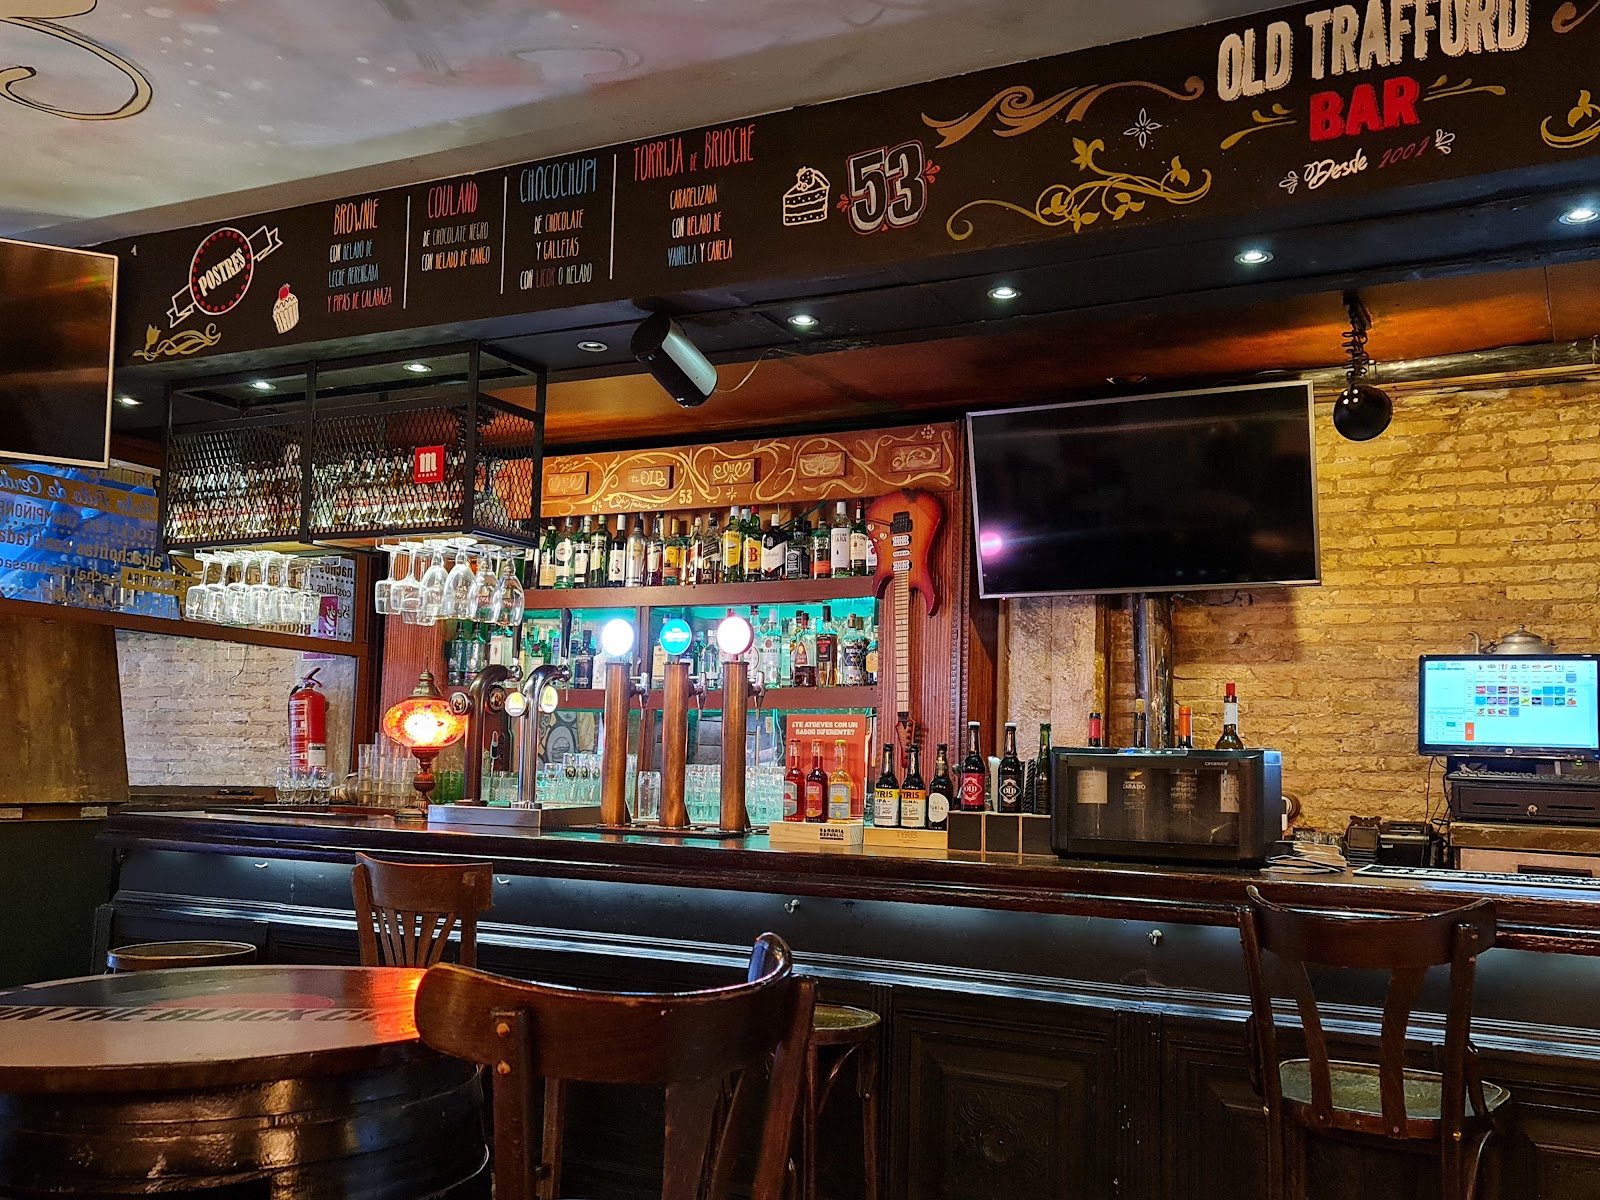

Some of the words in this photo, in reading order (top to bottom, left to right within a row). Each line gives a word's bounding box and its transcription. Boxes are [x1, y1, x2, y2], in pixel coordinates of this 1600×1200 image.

[1217, 20, 1294, 101] OLD
[1305, 0, 1530, 80] TRAFFORD
[1309, 75, 1421, 142] BAR
[633, 137, 684, 182] TORRIJA
[689, 151, 698, 172] DE
[703, 123, 756, 170] BRIOCHE
[519, 156, 598, 203] CHOCOCHUPI
[1304, 148, 1369, 190] Desde
[428, 180, 478, 219] COULAND
[669, 183, 718, 211] CARAMELIZADA
[847, 141, 927, 234] 53
[334, 198, 379, 235] BROWNIE
[534, 214, 543, 235] DE
[545, 208, 584, 233] CHOCOLATE
[671, 215, 685, 239] CON
[686, 212, 712, 236] HELADO
[433, 224, 467, 246] CHOCOLATE
[469, 221, 489, 241] NEGRO
[330, 243, 341, 263] CON
[421, 253, 434, 272] CON
[435, 249, 459, 270] HELADO
[470, 246, 491, 265] MANGO
[536, 241, 541, 260] Y
[543, 237, 580, 260] GALLETAS
[700, 242, 705, 263] Y
[707, 238, 733, 262] CANELA
[198, 247, 246, 297] POSTRES
[520, 268, 534, 290] CON
[566, 262, 593, 285] HELADO
[679, 488, 693, 504] 53
